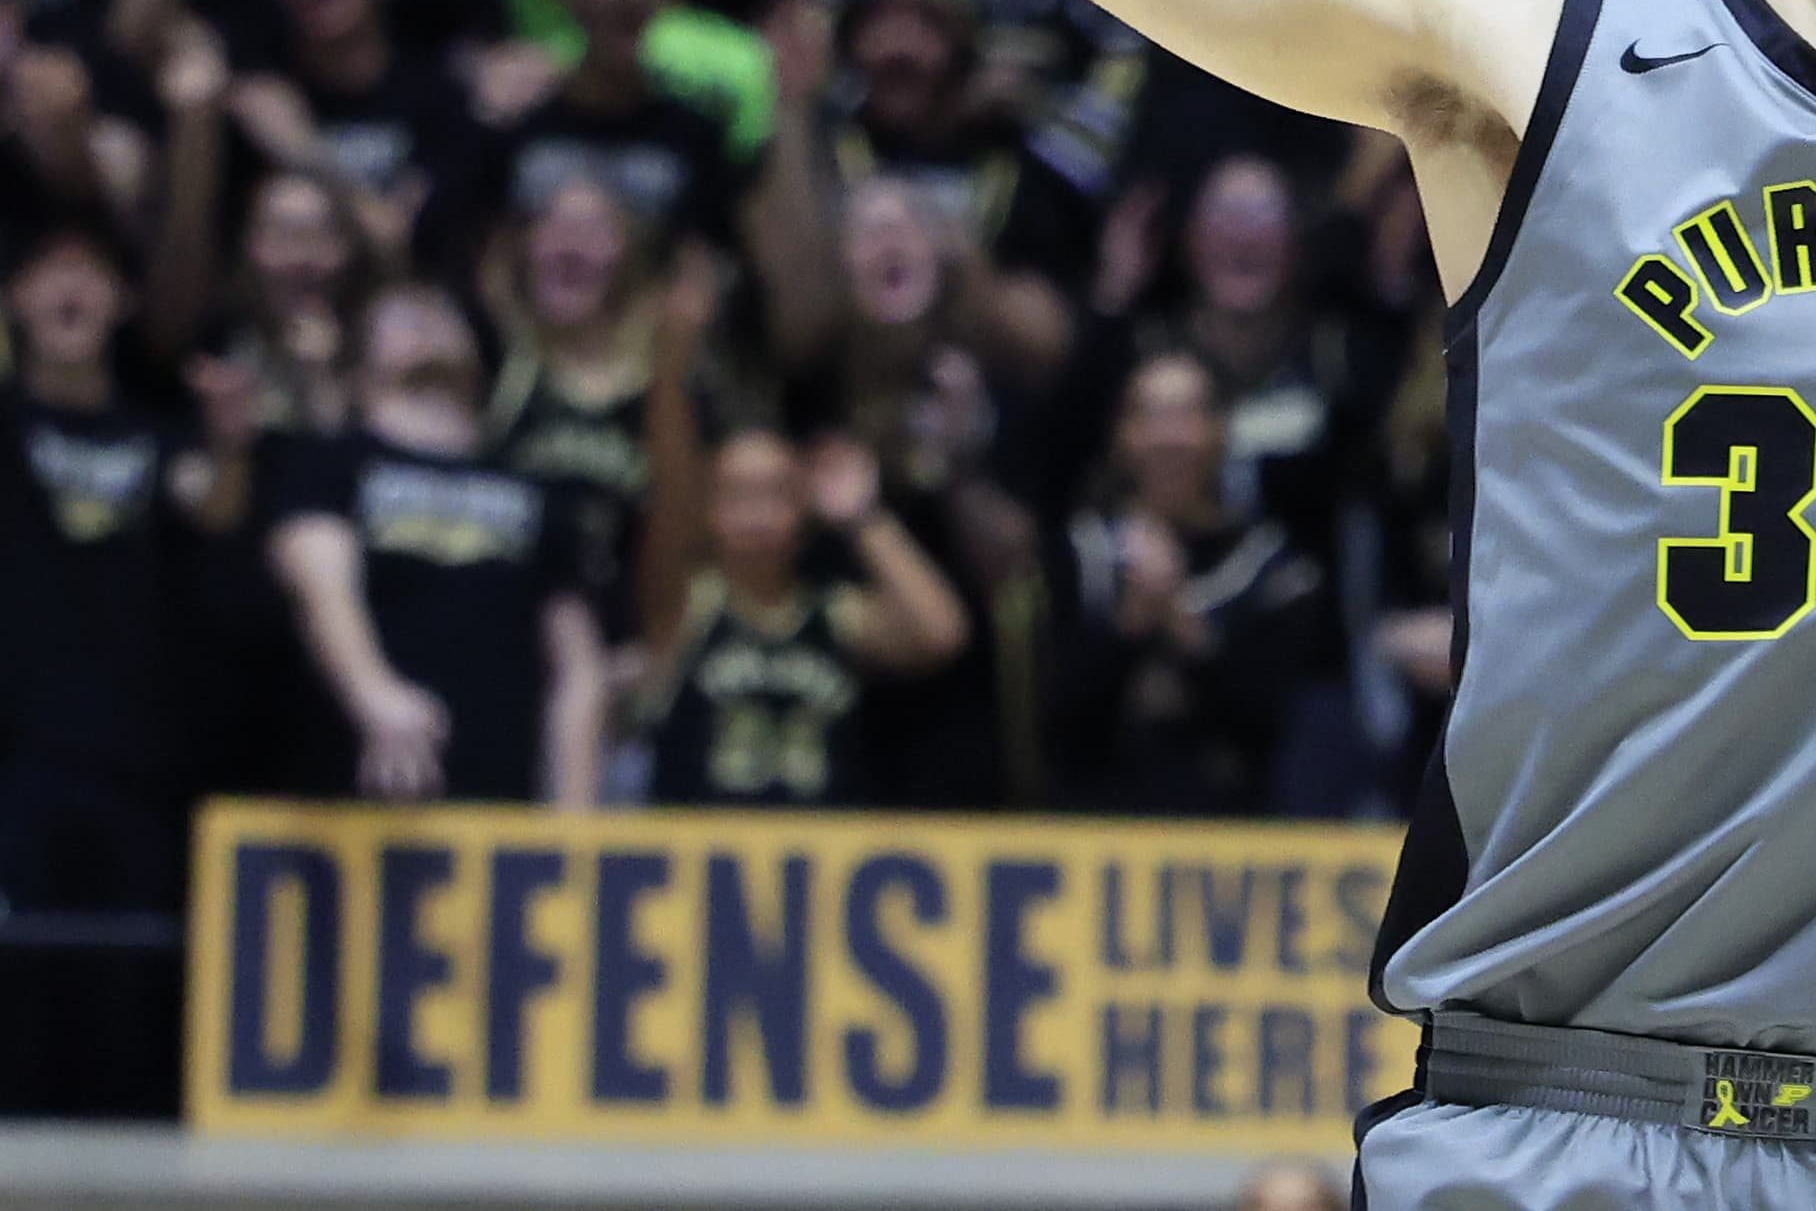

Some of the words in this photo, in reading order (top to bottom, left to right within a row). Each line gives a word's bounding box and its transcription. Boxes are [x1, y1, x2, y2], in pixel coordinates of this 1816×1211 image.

[1103, 862, 1386, 972] LIVES
[229, 843, 1064, 1113] DEFENSE
[1103, 1004, 1382, 1119] HERE
[1704, 1077, 1774, 1106] DWN
[1700, 1101, 1810, 1134] CNCER
